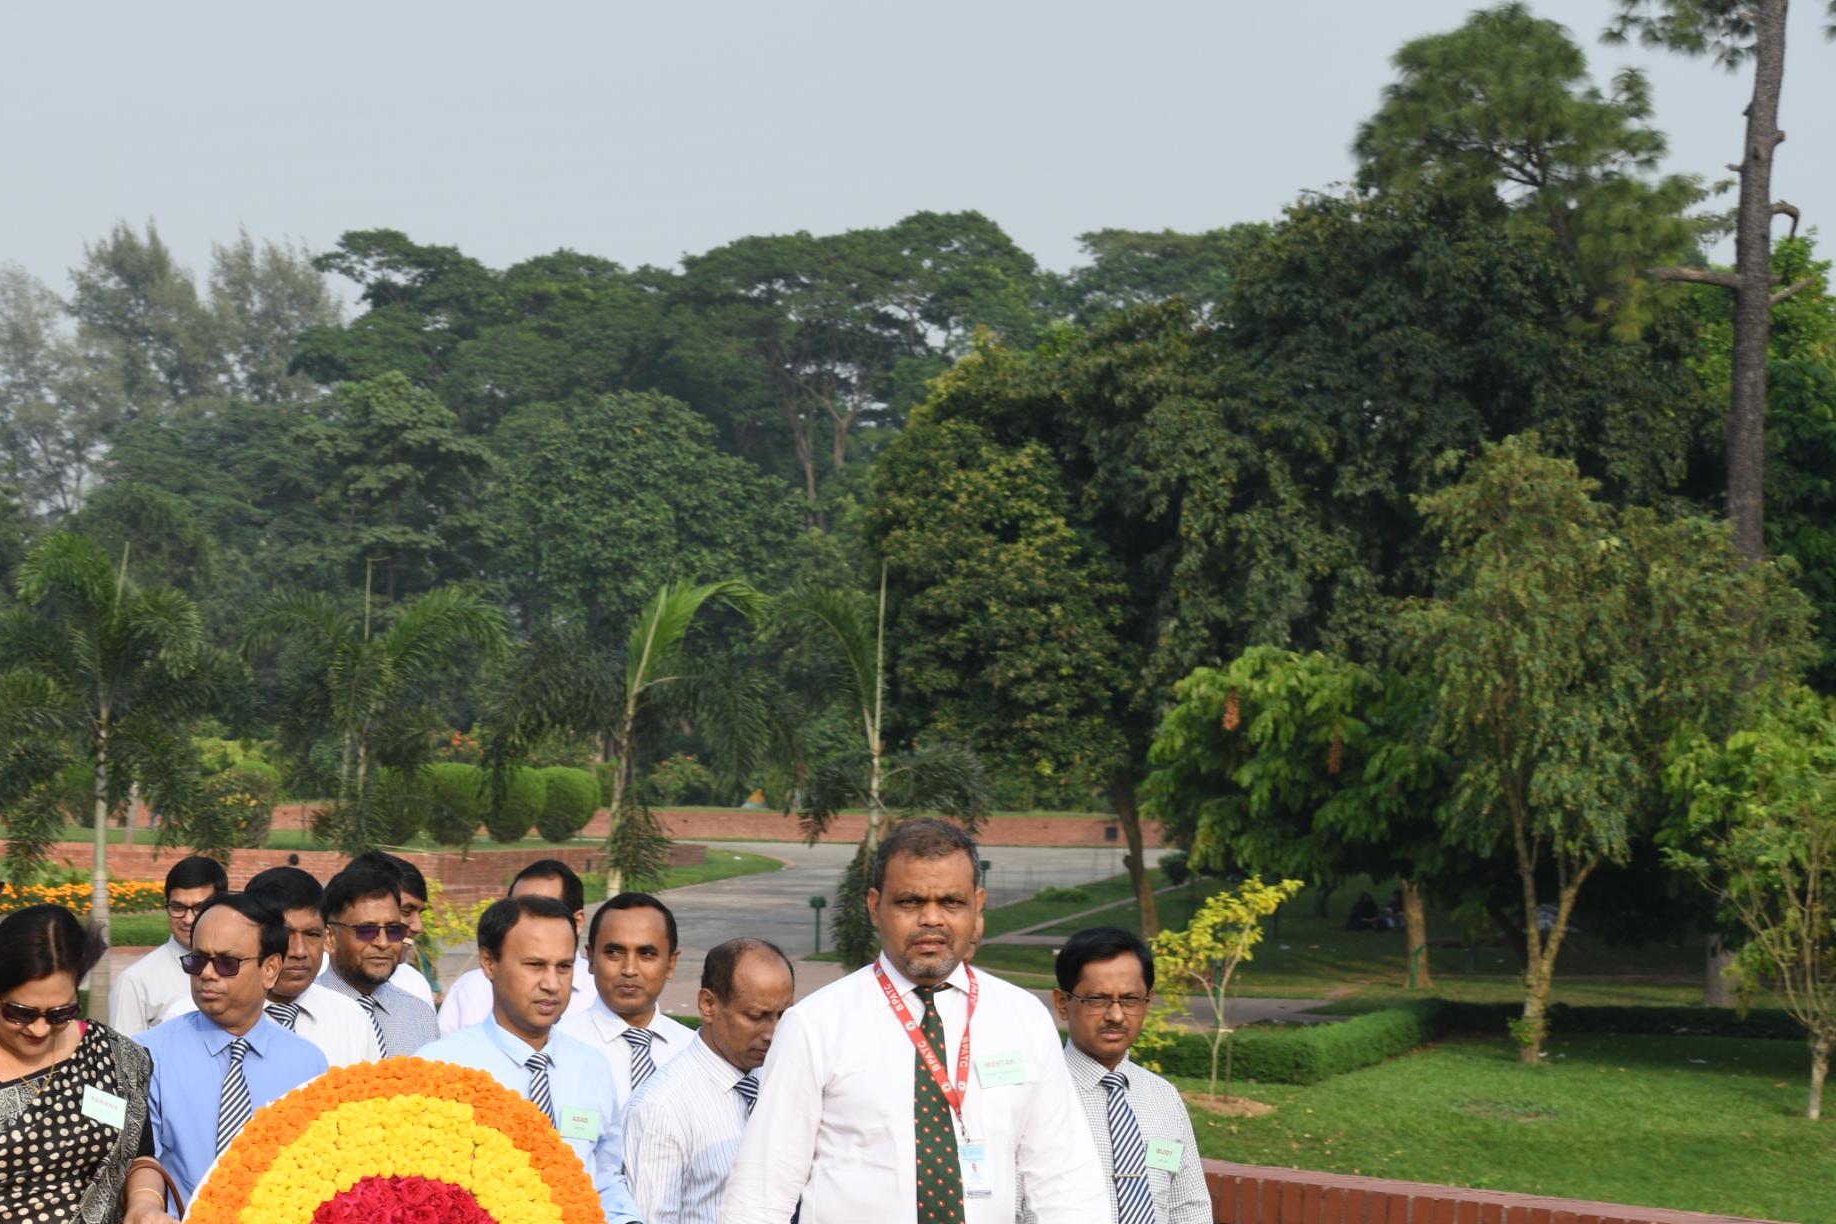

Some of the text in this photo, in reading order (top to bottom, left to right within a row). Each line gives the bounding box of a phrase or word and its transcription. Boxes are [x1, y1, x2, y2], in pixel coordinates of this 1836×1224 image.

[883, 983, 905, 1011] BPATC
[917, 1040, 941, 1072] BPATC
[959, 1035, 969, 1067] BPATC
